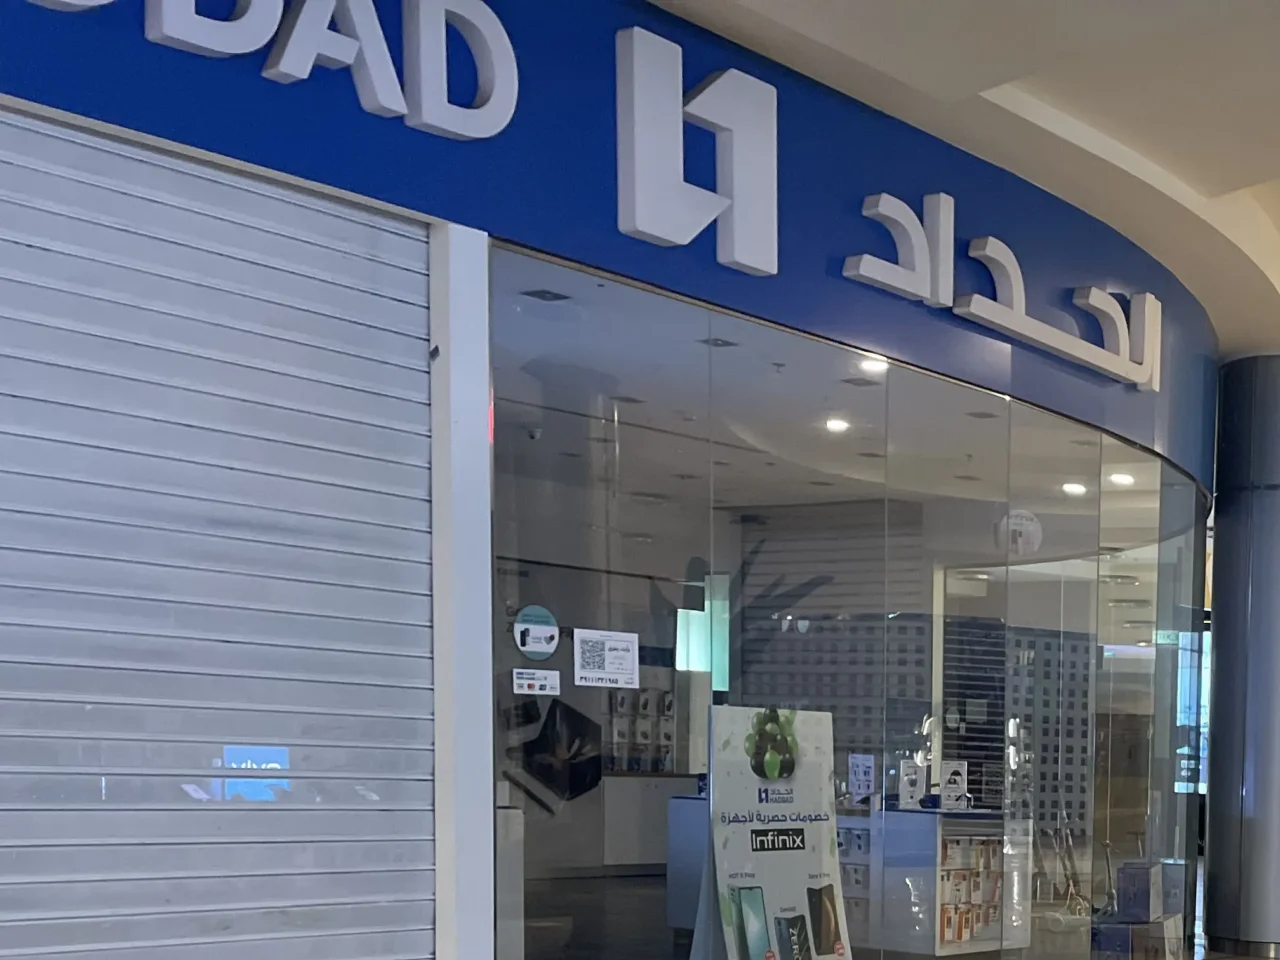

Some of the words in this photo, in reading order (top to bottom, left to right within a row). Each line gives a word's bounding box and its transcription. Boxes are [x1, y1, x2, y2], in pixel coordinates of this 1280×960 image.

[720, 809, 754, 826] لأجهزة
[755, 811, 787, 825] حصرية
[789, 811, 830, 825] خصومات
[752, 831, 803, 850] Infinix
